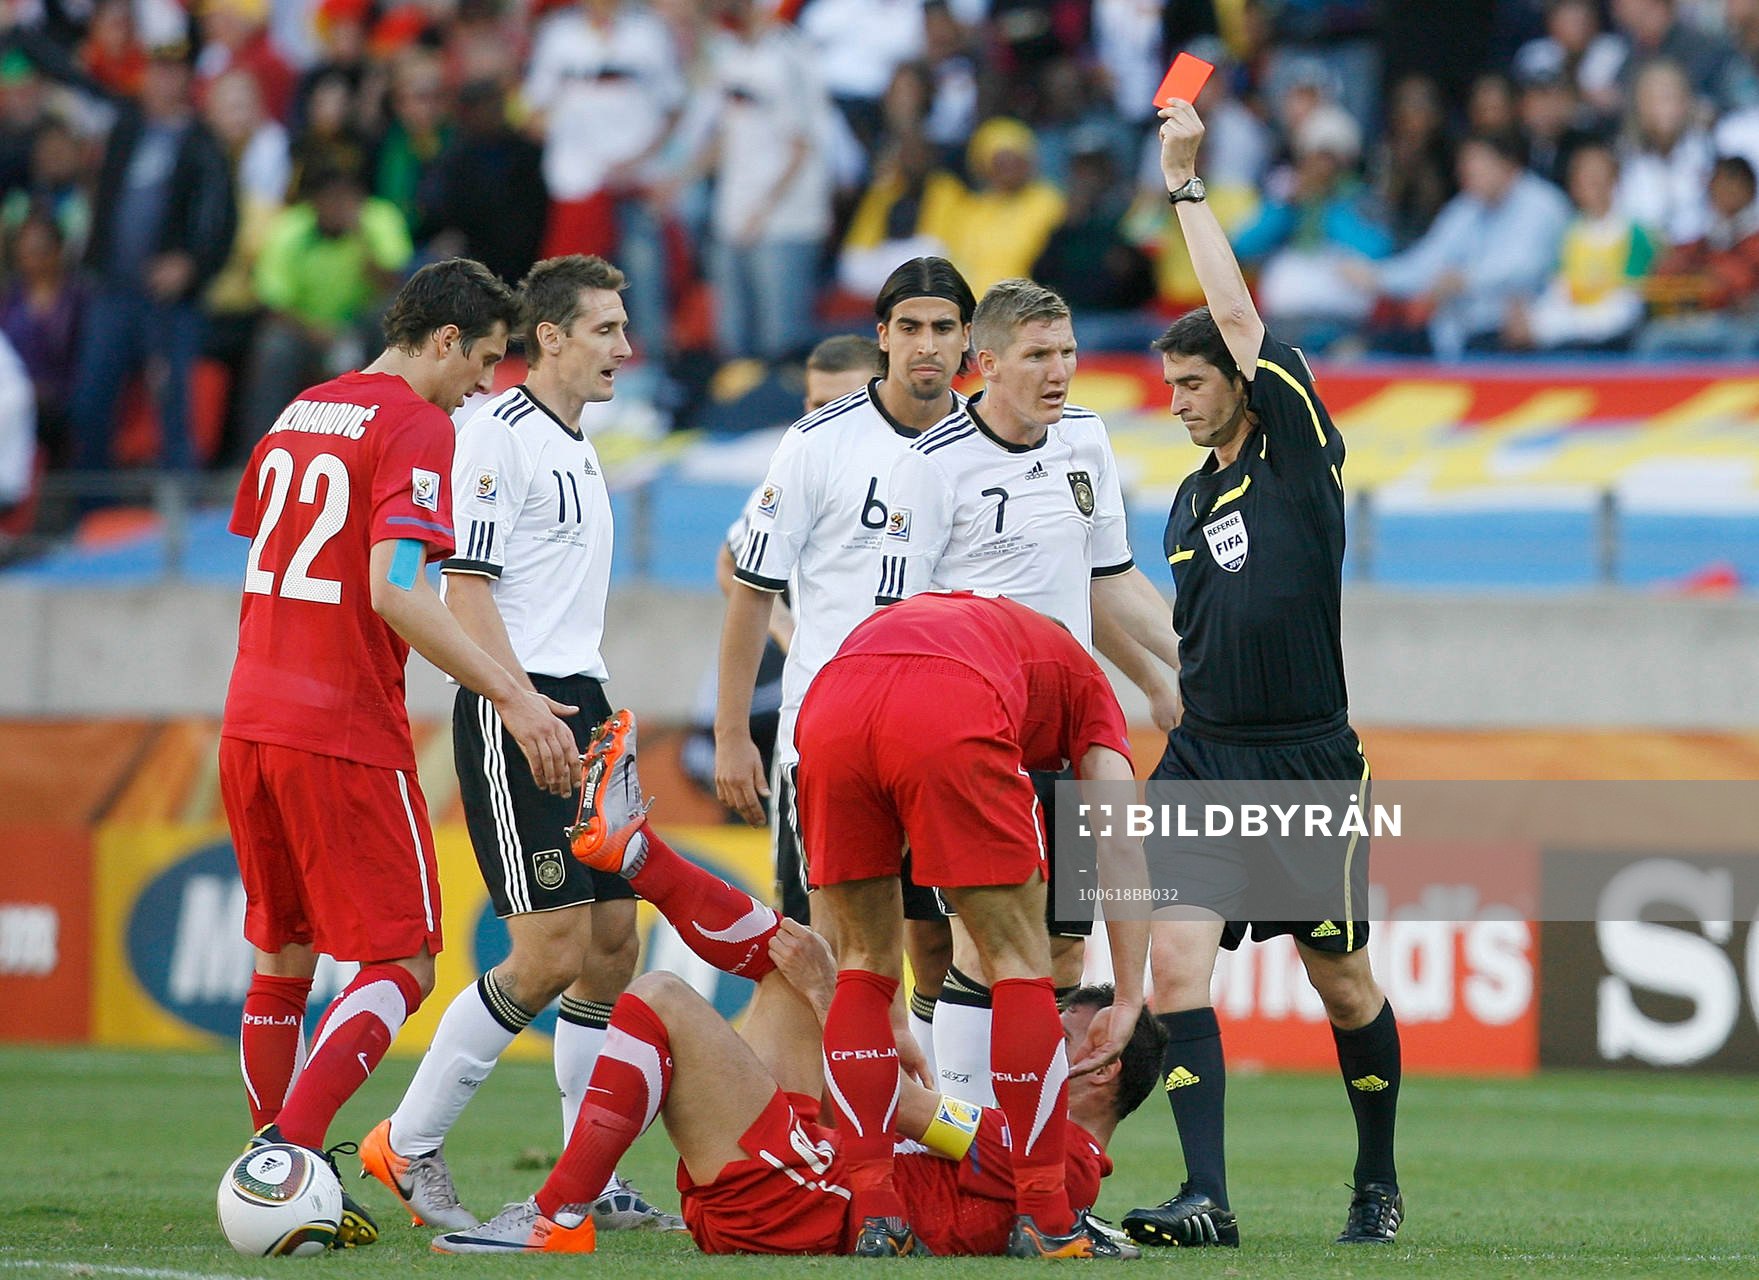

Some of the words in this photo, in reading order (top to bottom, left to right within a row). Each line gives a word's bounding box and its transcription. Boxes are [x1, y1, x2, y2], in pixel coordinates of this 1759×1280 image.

[1024, 471, 1049, 480] adidas
[552, 469, 582, 524] 11
[861, 476, 888, 529] 6
[981, 487, 1009, 533] 7
[244, 448, 350, 604] 22
[1207, 516, 1240, 537] REFEREE
[1216, 534, 1243, 555] FIFA
[583, 782, 596, 809] NIKE
[1311, 929, 1341, 938] adidas
[1594, 858, 1759, 1066] S
